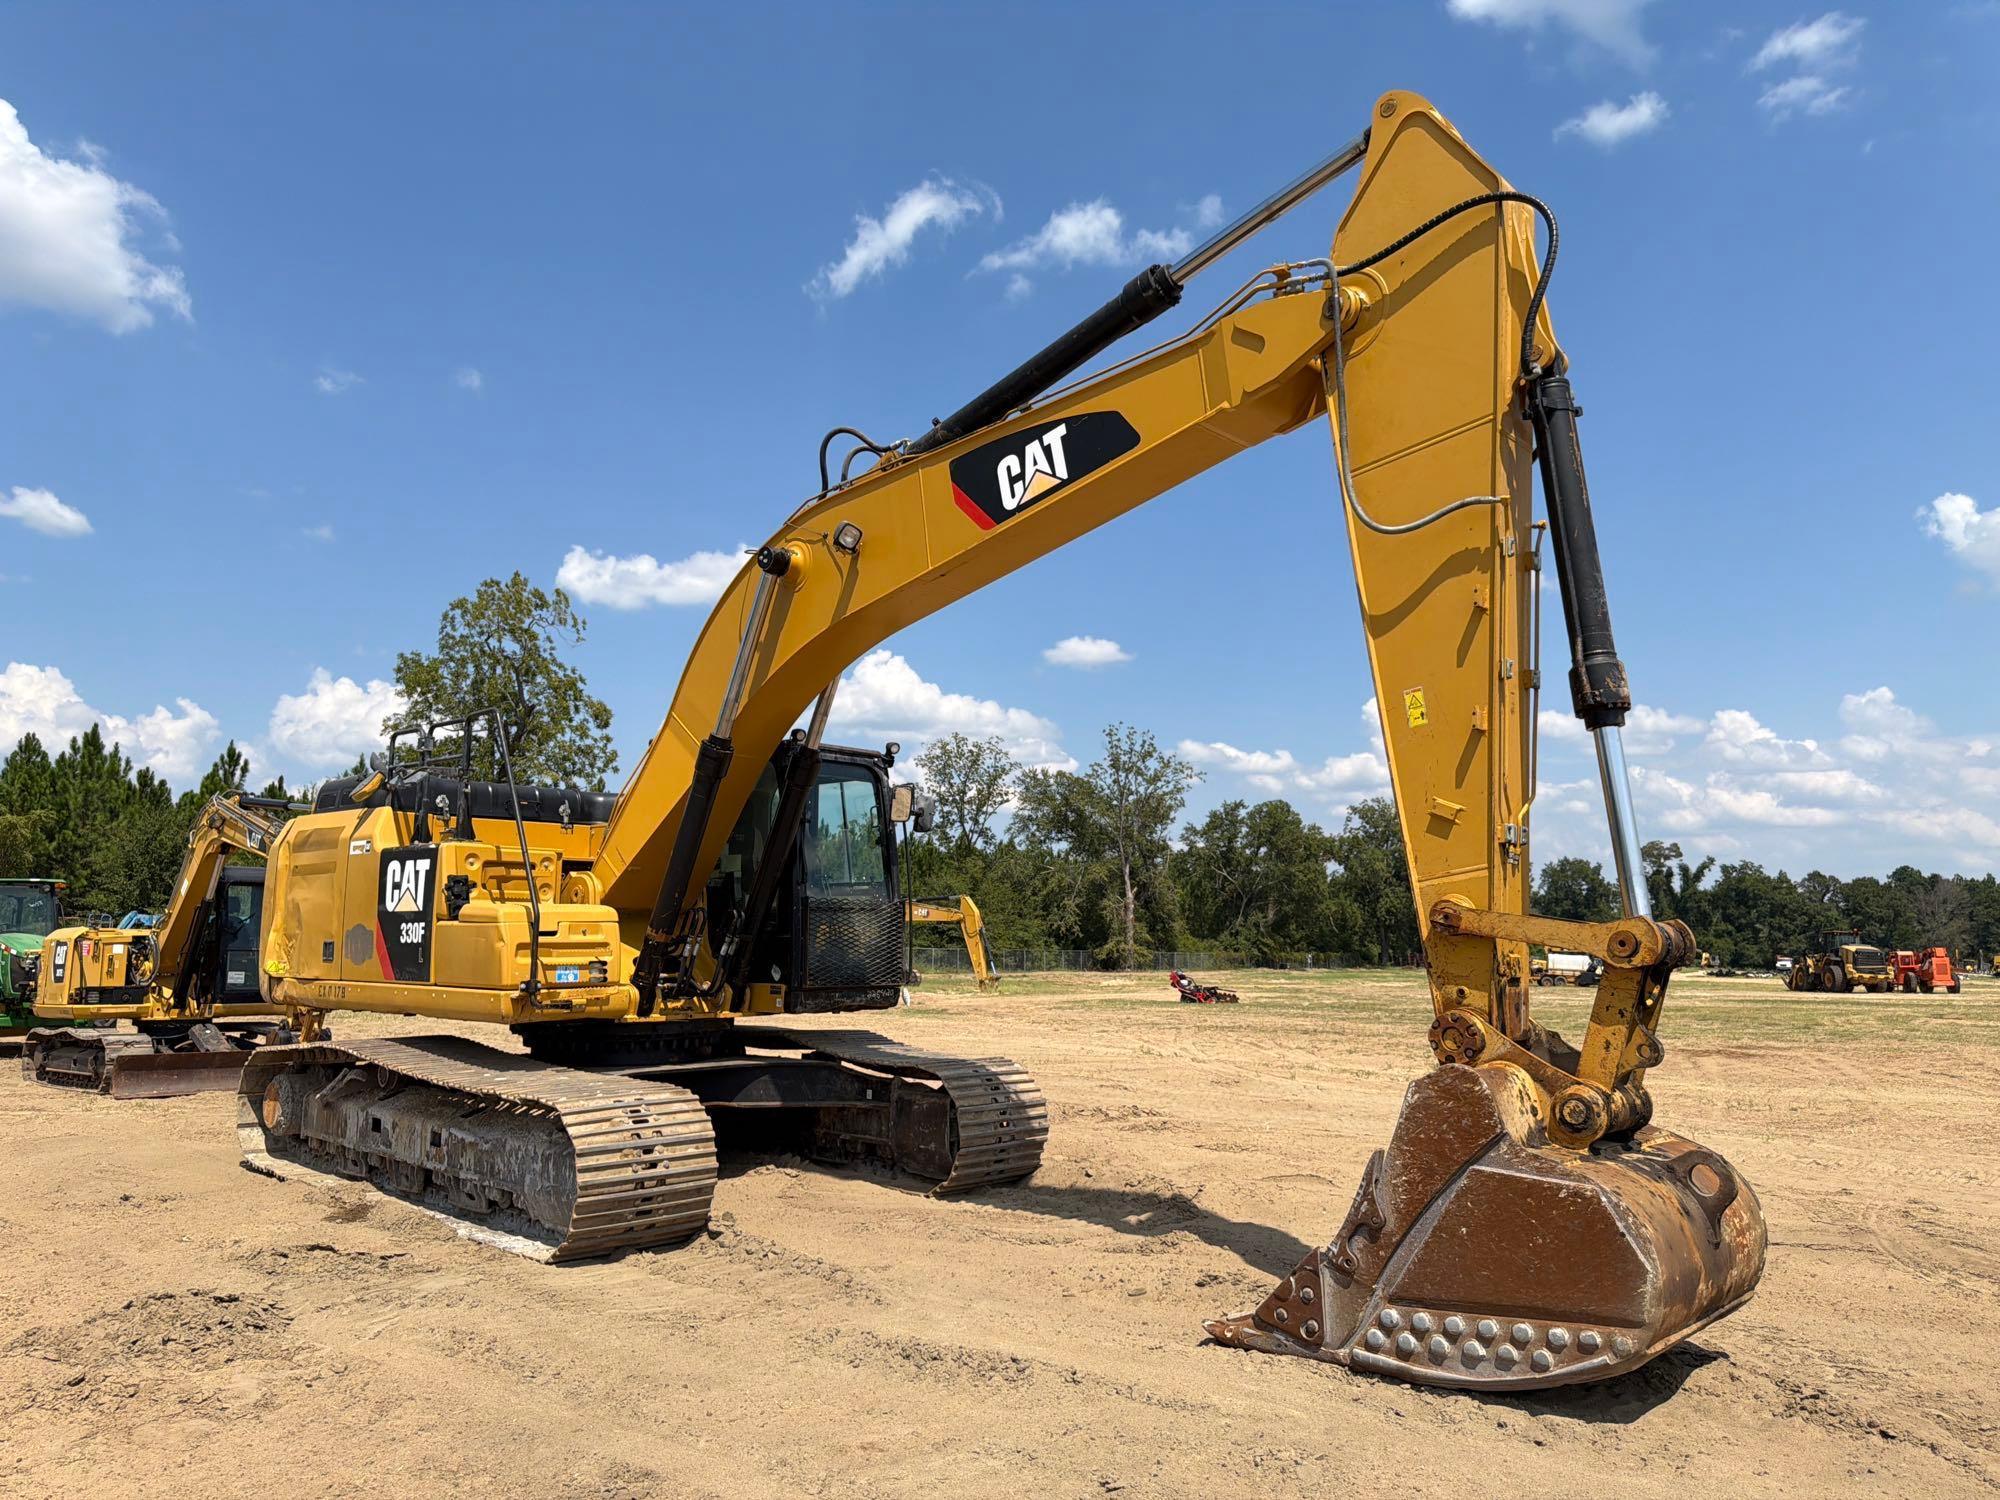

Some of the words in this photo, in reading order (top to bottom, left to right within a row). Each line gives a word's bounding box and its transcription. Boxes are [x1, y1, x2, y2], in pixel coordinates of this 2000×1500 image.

[997, 423, 1068, 510] CAT
[385, 859, 431, 912] CAT
[400, 922, 425, 944] 330F
[55, 946, 67, 964] CAT
